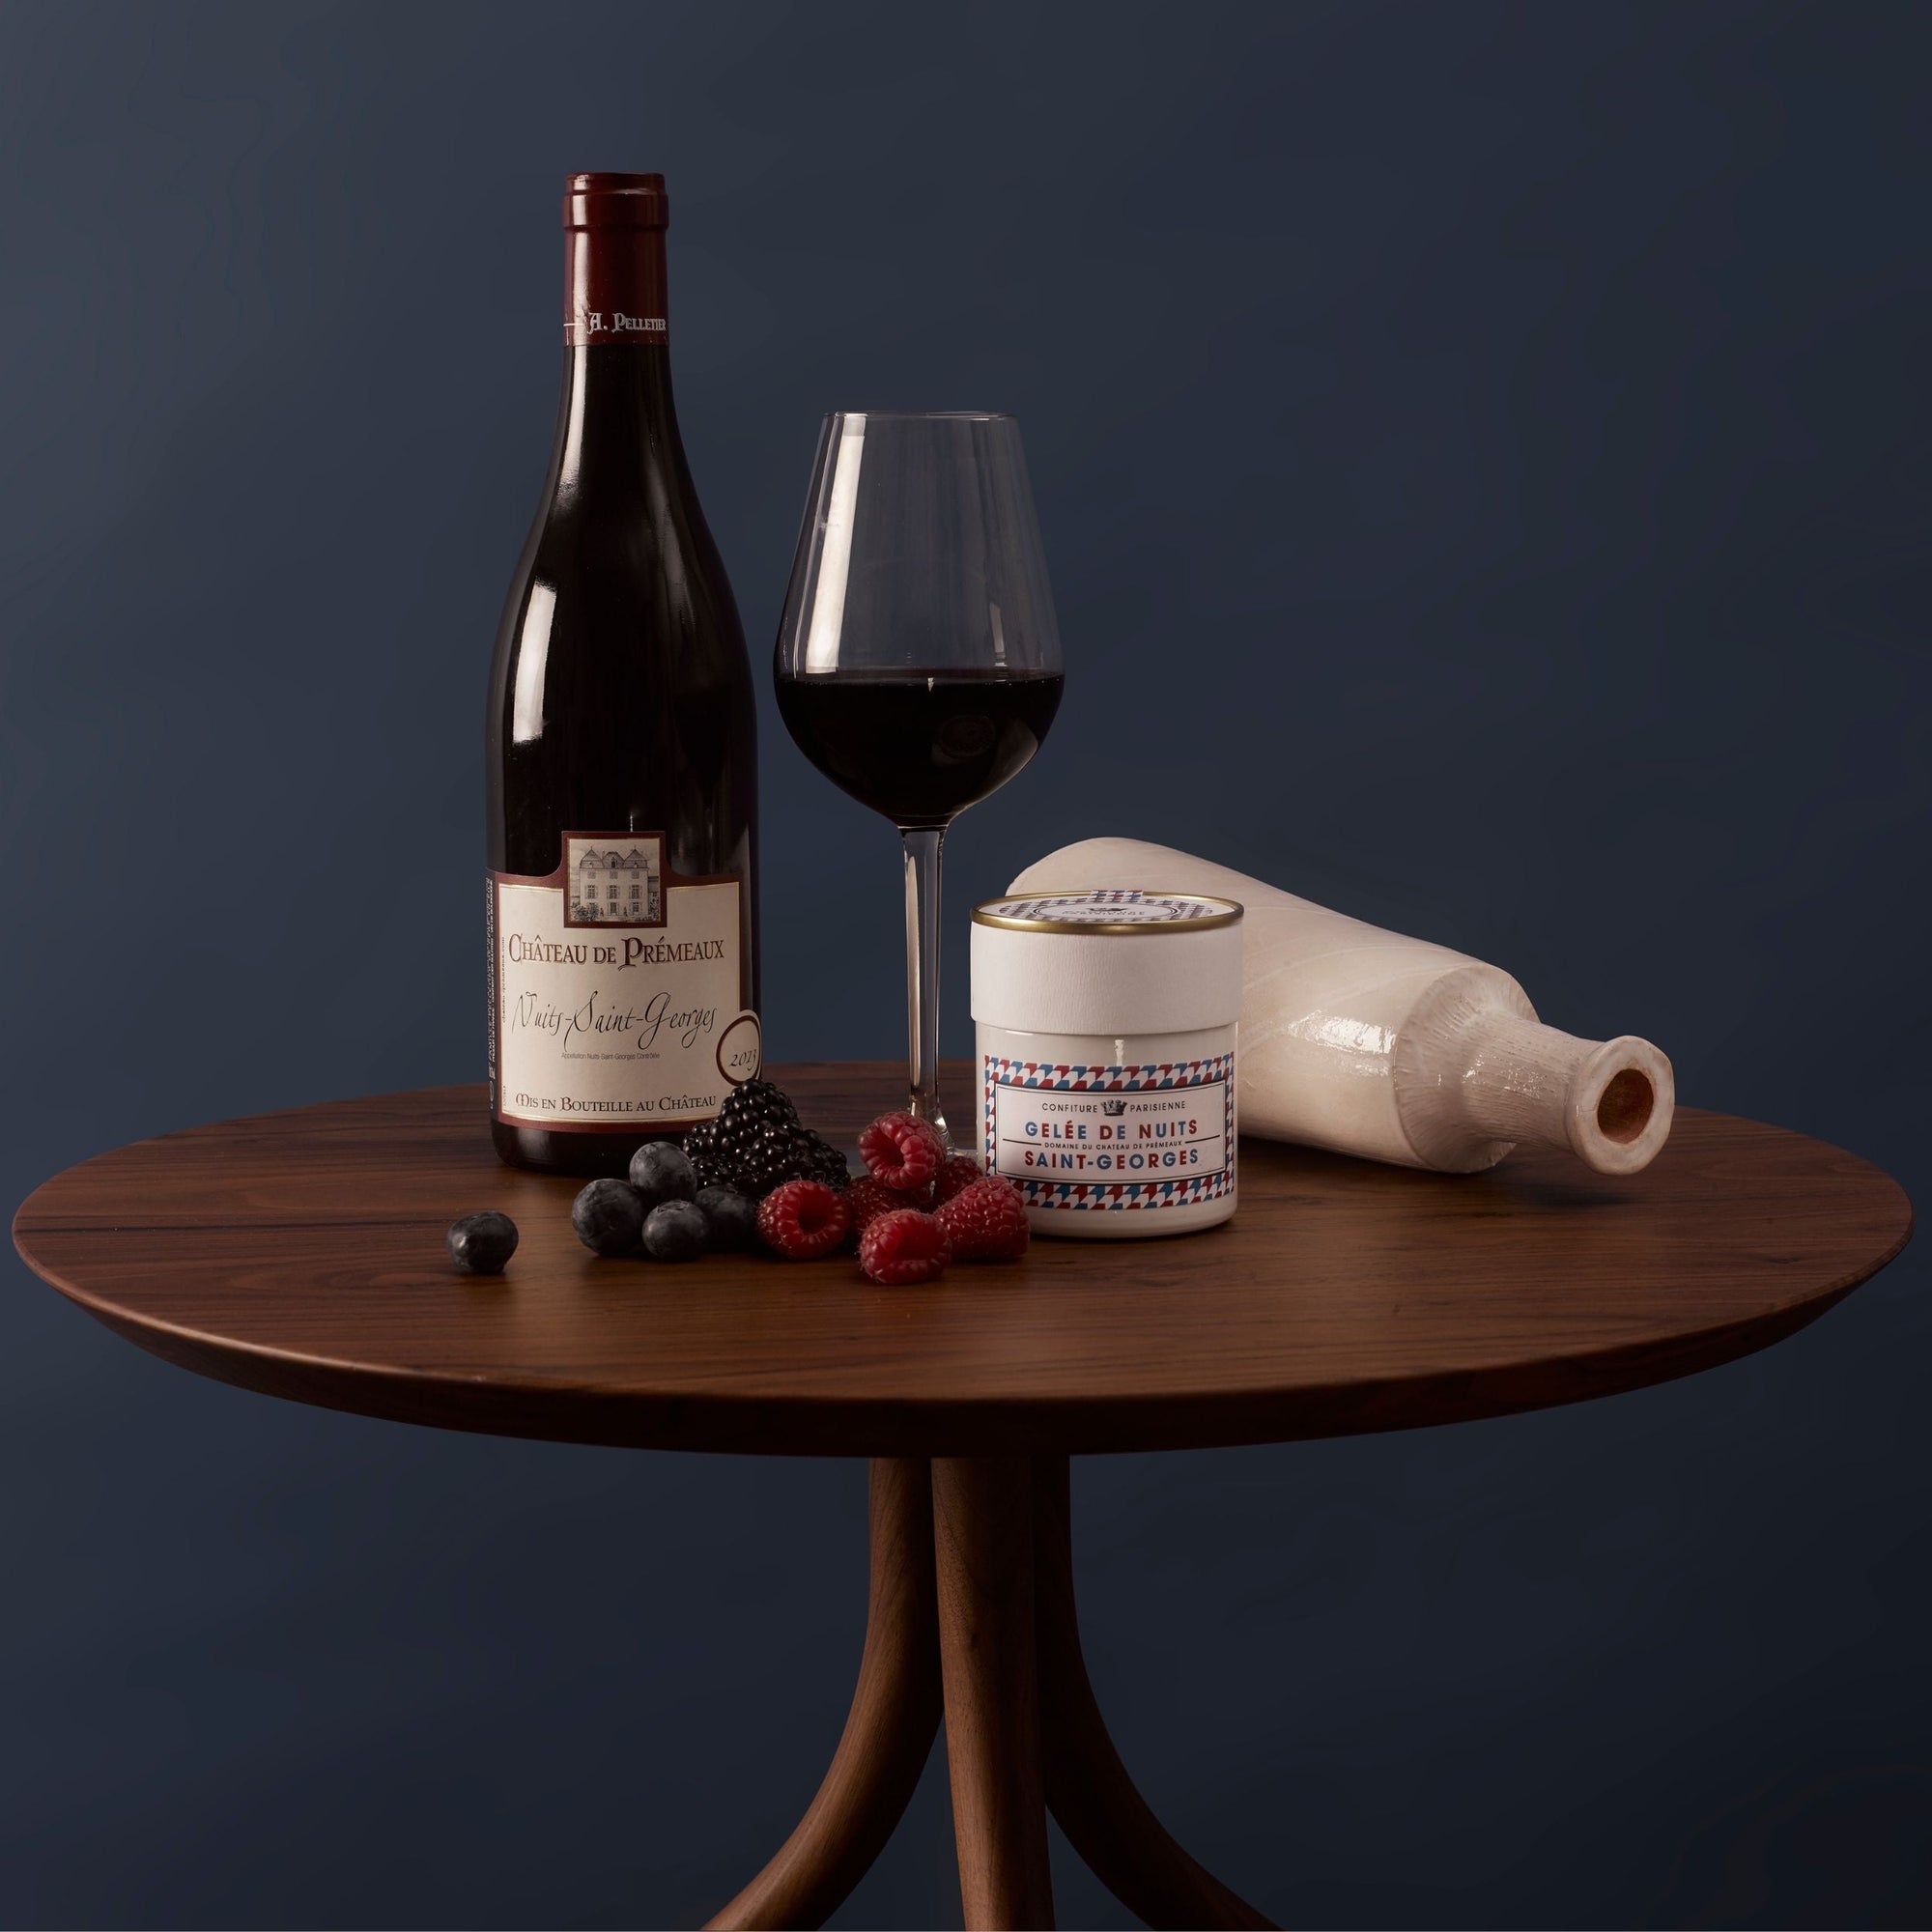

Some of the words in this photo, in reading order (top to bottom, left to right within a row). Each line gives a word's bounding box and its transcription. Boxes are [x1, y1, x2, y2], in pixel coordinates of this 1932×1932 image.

[586, 312, 609, 335] A.
[508, 933, 588, 965] CHÂTEAU
[592, 947, 616, 964] DE
[617, 935, 724, 972] PRÉMEAUX
[511, 990, 718, 1052] Nuits-Saint-Georges
[515, 1093, 539, 1108] MIS
[541, 1099, 556, 1110] EN
[560, 1096, 634, 1112] BOUTEILLE
[637, 1101, 655, 1112] AU
[659, 1094, 717, 1110] CHÂTEAU
[1041, 1102, 1098, 1113] CONFITURE
[1130, 1100, 1186, 1112] PARISIENNE
[1025, 1121, 1087, 1140] GELÉE
[1099, 1125, 1126, 1140] DE
[1139, 1120, 1198, 1139] NUITS
[1025, 1149, 1199, 1170] SAINT-GEORGES
